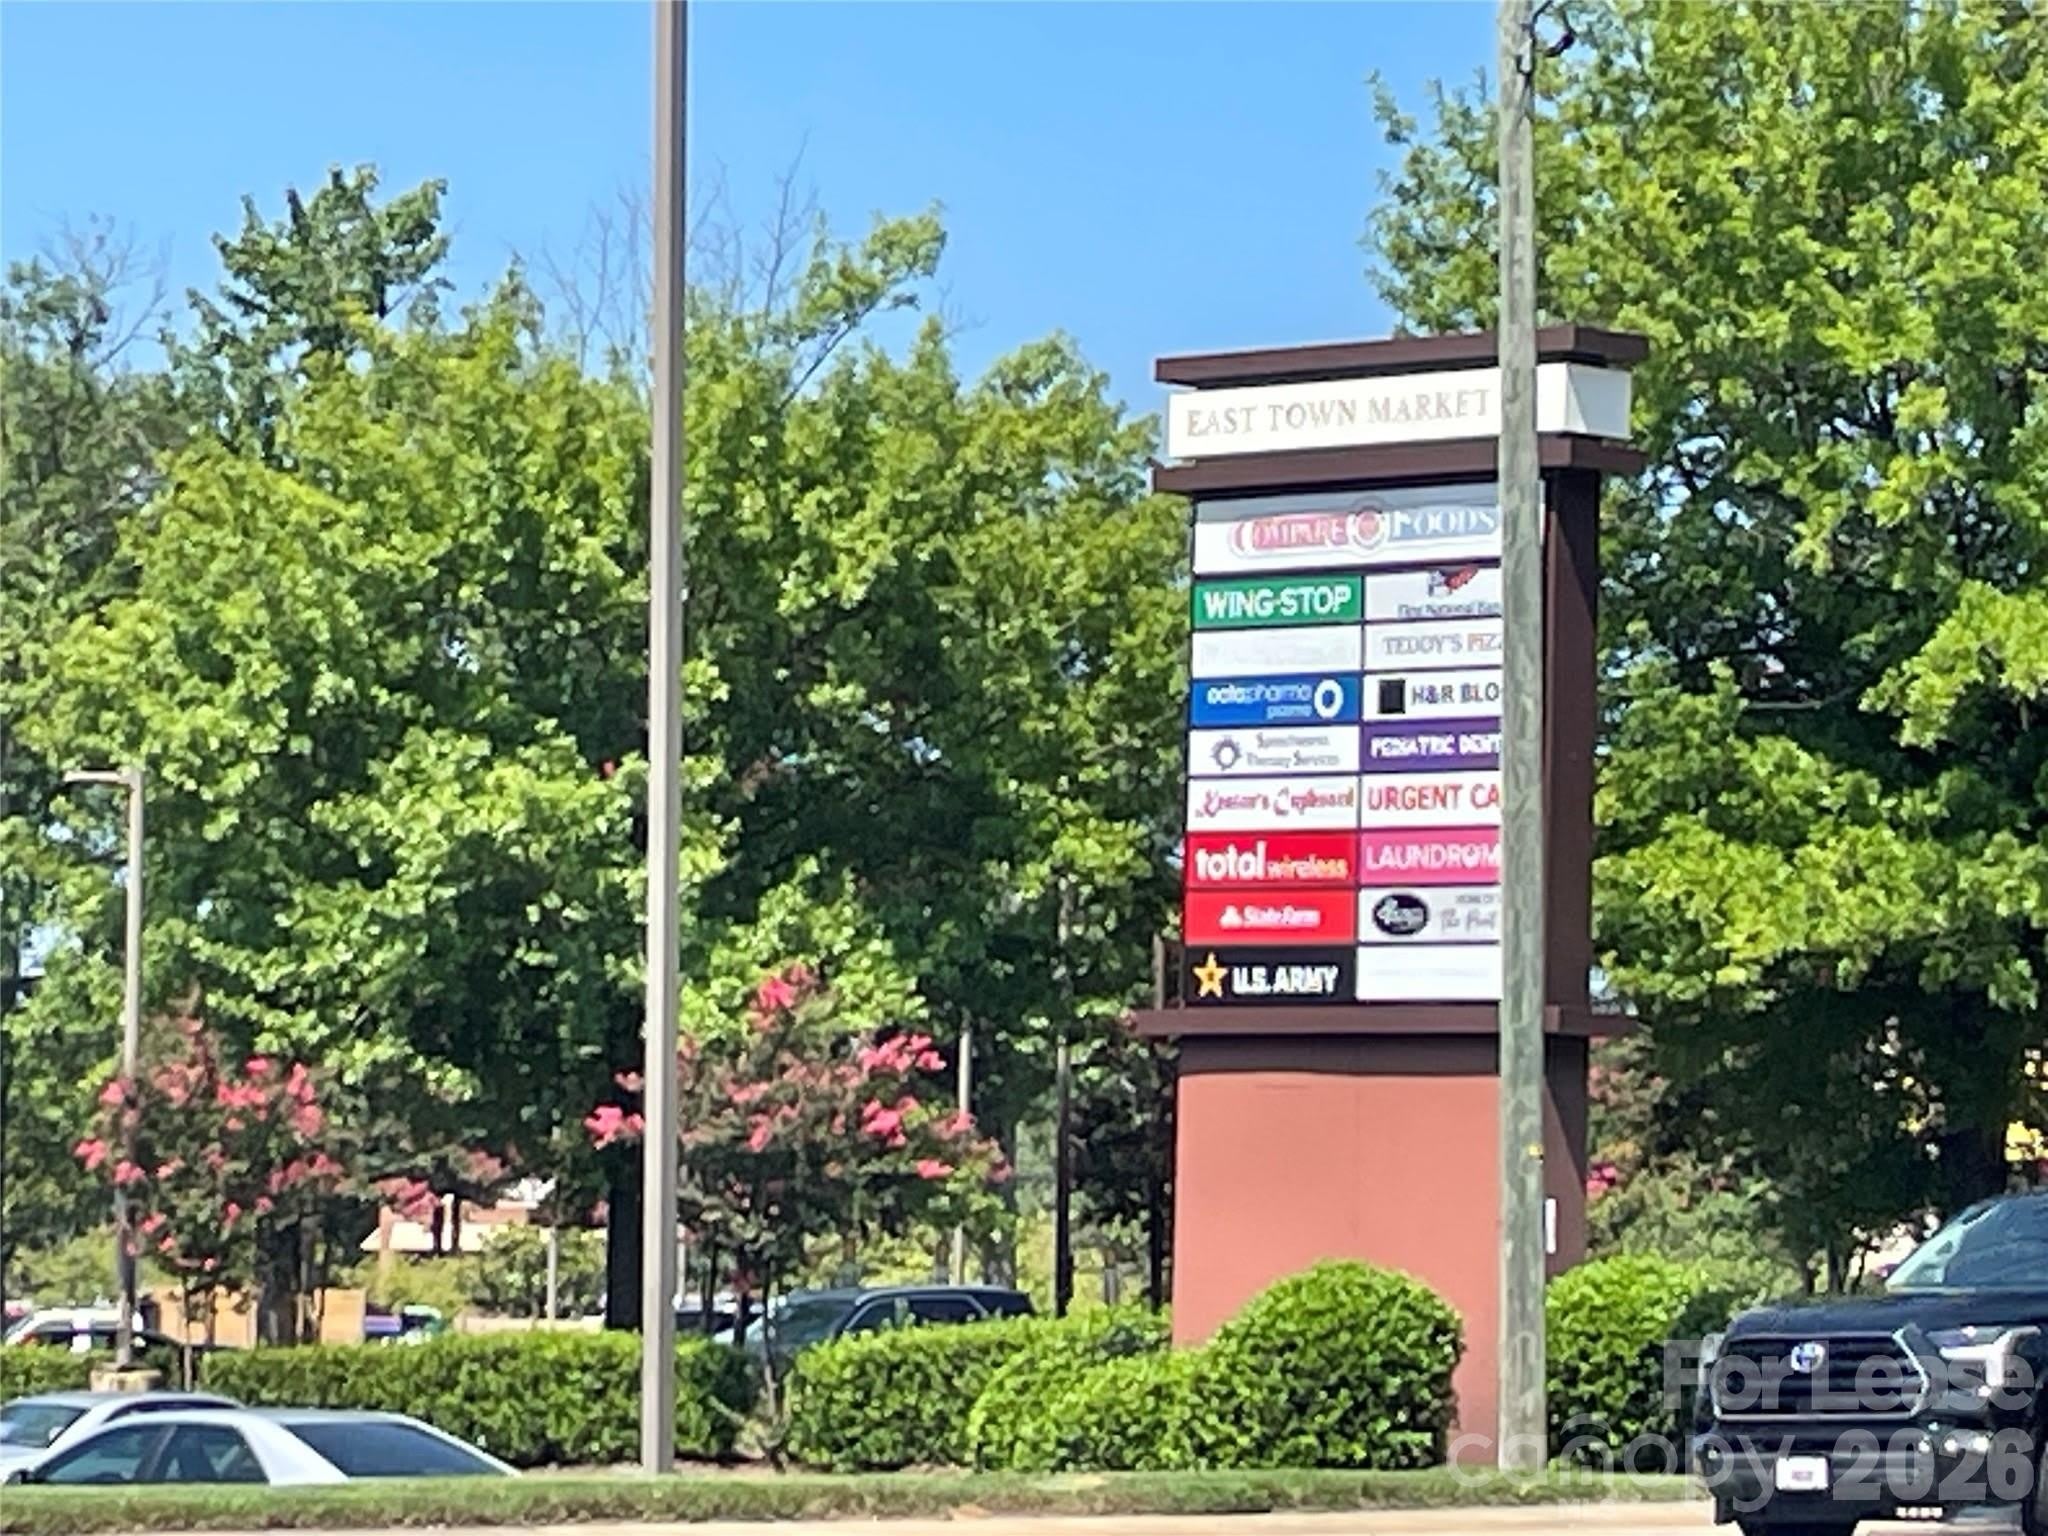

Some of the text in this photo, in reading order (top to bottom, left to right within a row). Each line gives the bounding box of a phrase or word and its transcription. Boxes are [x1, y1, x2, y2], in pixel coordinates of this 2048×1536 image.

[1186, 389, 1490, 437] EAST TOWN MARKET
[1391, 507, 1497, 539] FOODS
[1382, 633, 1463, 656] TEDDY'S
[1411, 683, 1455, 706] H&R
[1370, 733, 1456, 758] PEDIATRIC
[1367, 782, 1464, 812] URGENT
[1194, 839, 1349, 881] total wireless
[1232, 964, 1339, 995] U.S. ARMY
